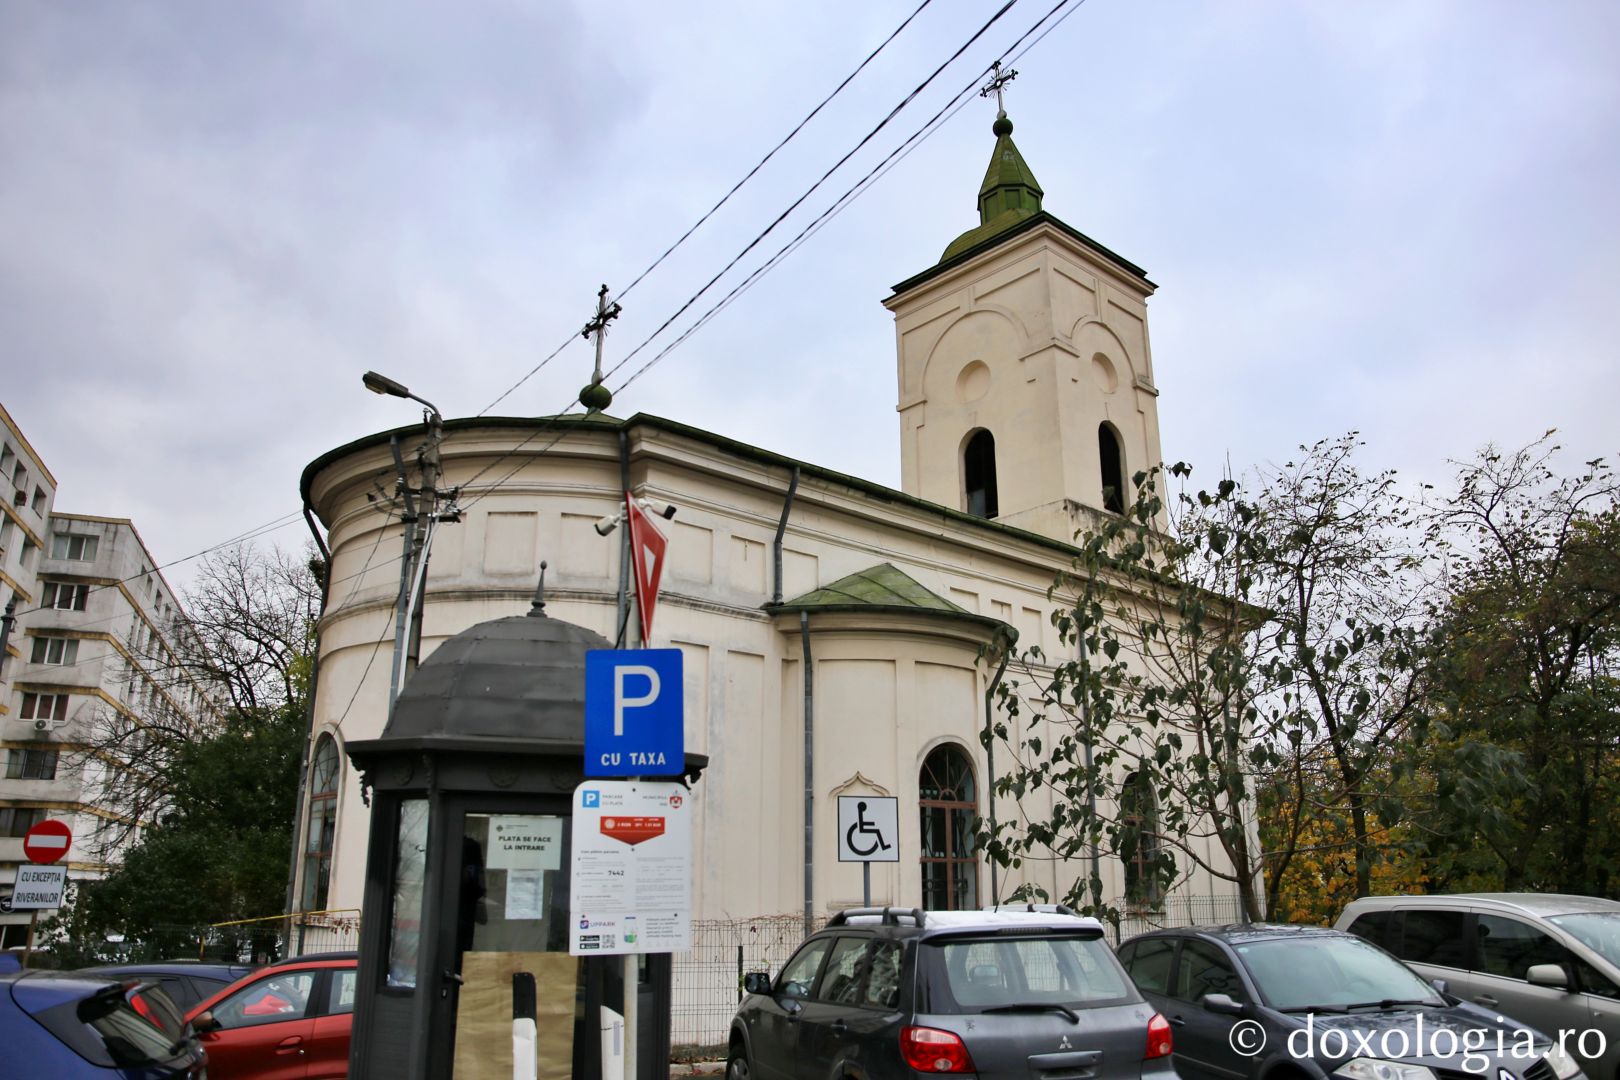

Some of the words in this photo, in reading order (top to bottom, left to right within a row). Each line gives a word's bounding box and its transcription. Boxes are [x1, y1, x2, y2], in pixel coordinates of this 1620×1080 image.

[614, 665, 661, 736] P
[601, 753, 621, 766] CU
[629, 752, 666, 766] TAXA
[21, 871, 31, 882] CU
[15, 892, 59, 903] RIVERANILOR
